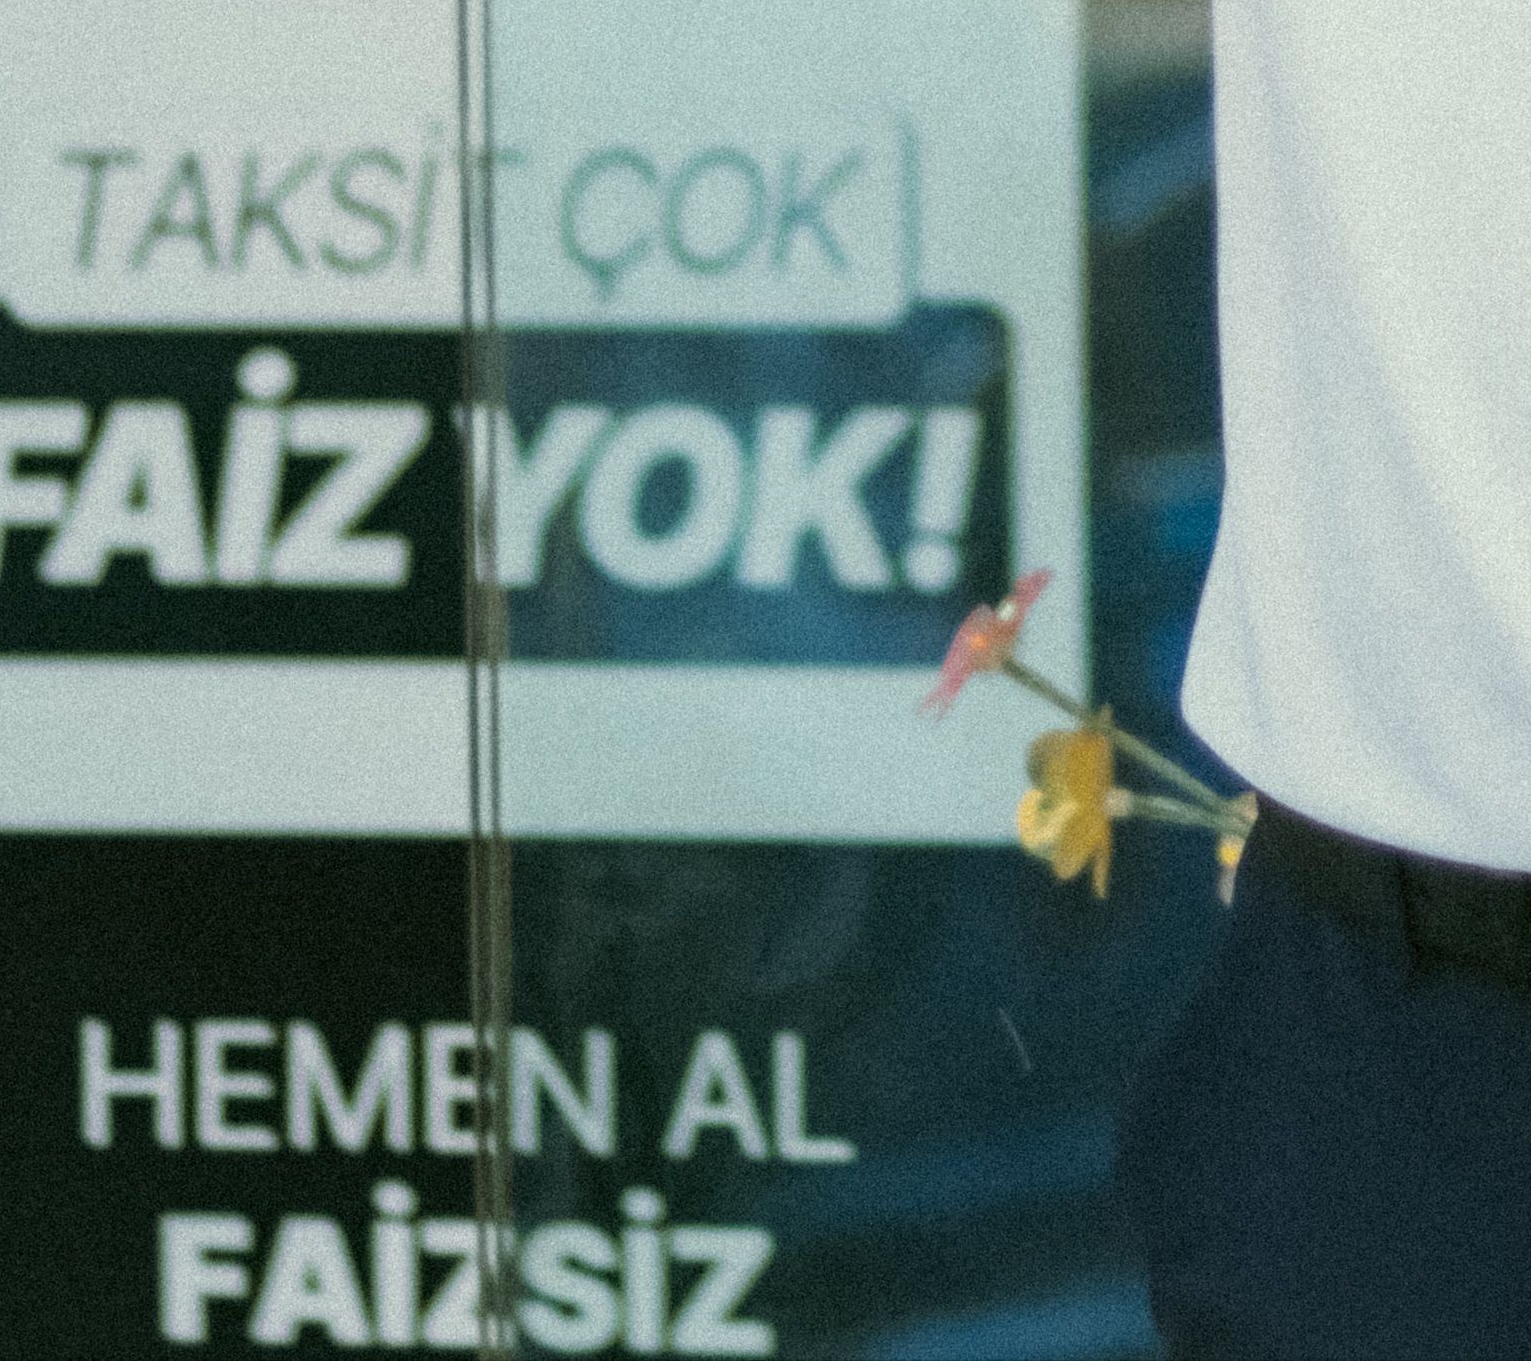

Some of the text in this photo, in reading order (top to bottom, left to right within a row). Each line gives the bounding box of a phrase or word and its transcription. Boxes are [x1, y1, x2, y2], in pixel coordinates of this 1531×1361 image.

[559, 141, 866, 302] ÇOK
[453, 402, 983, 594] YOK!
[78, 1018, 858, 1164] HEMEN AL
[156, 1177, 778, 1358] FAİZSİZ
